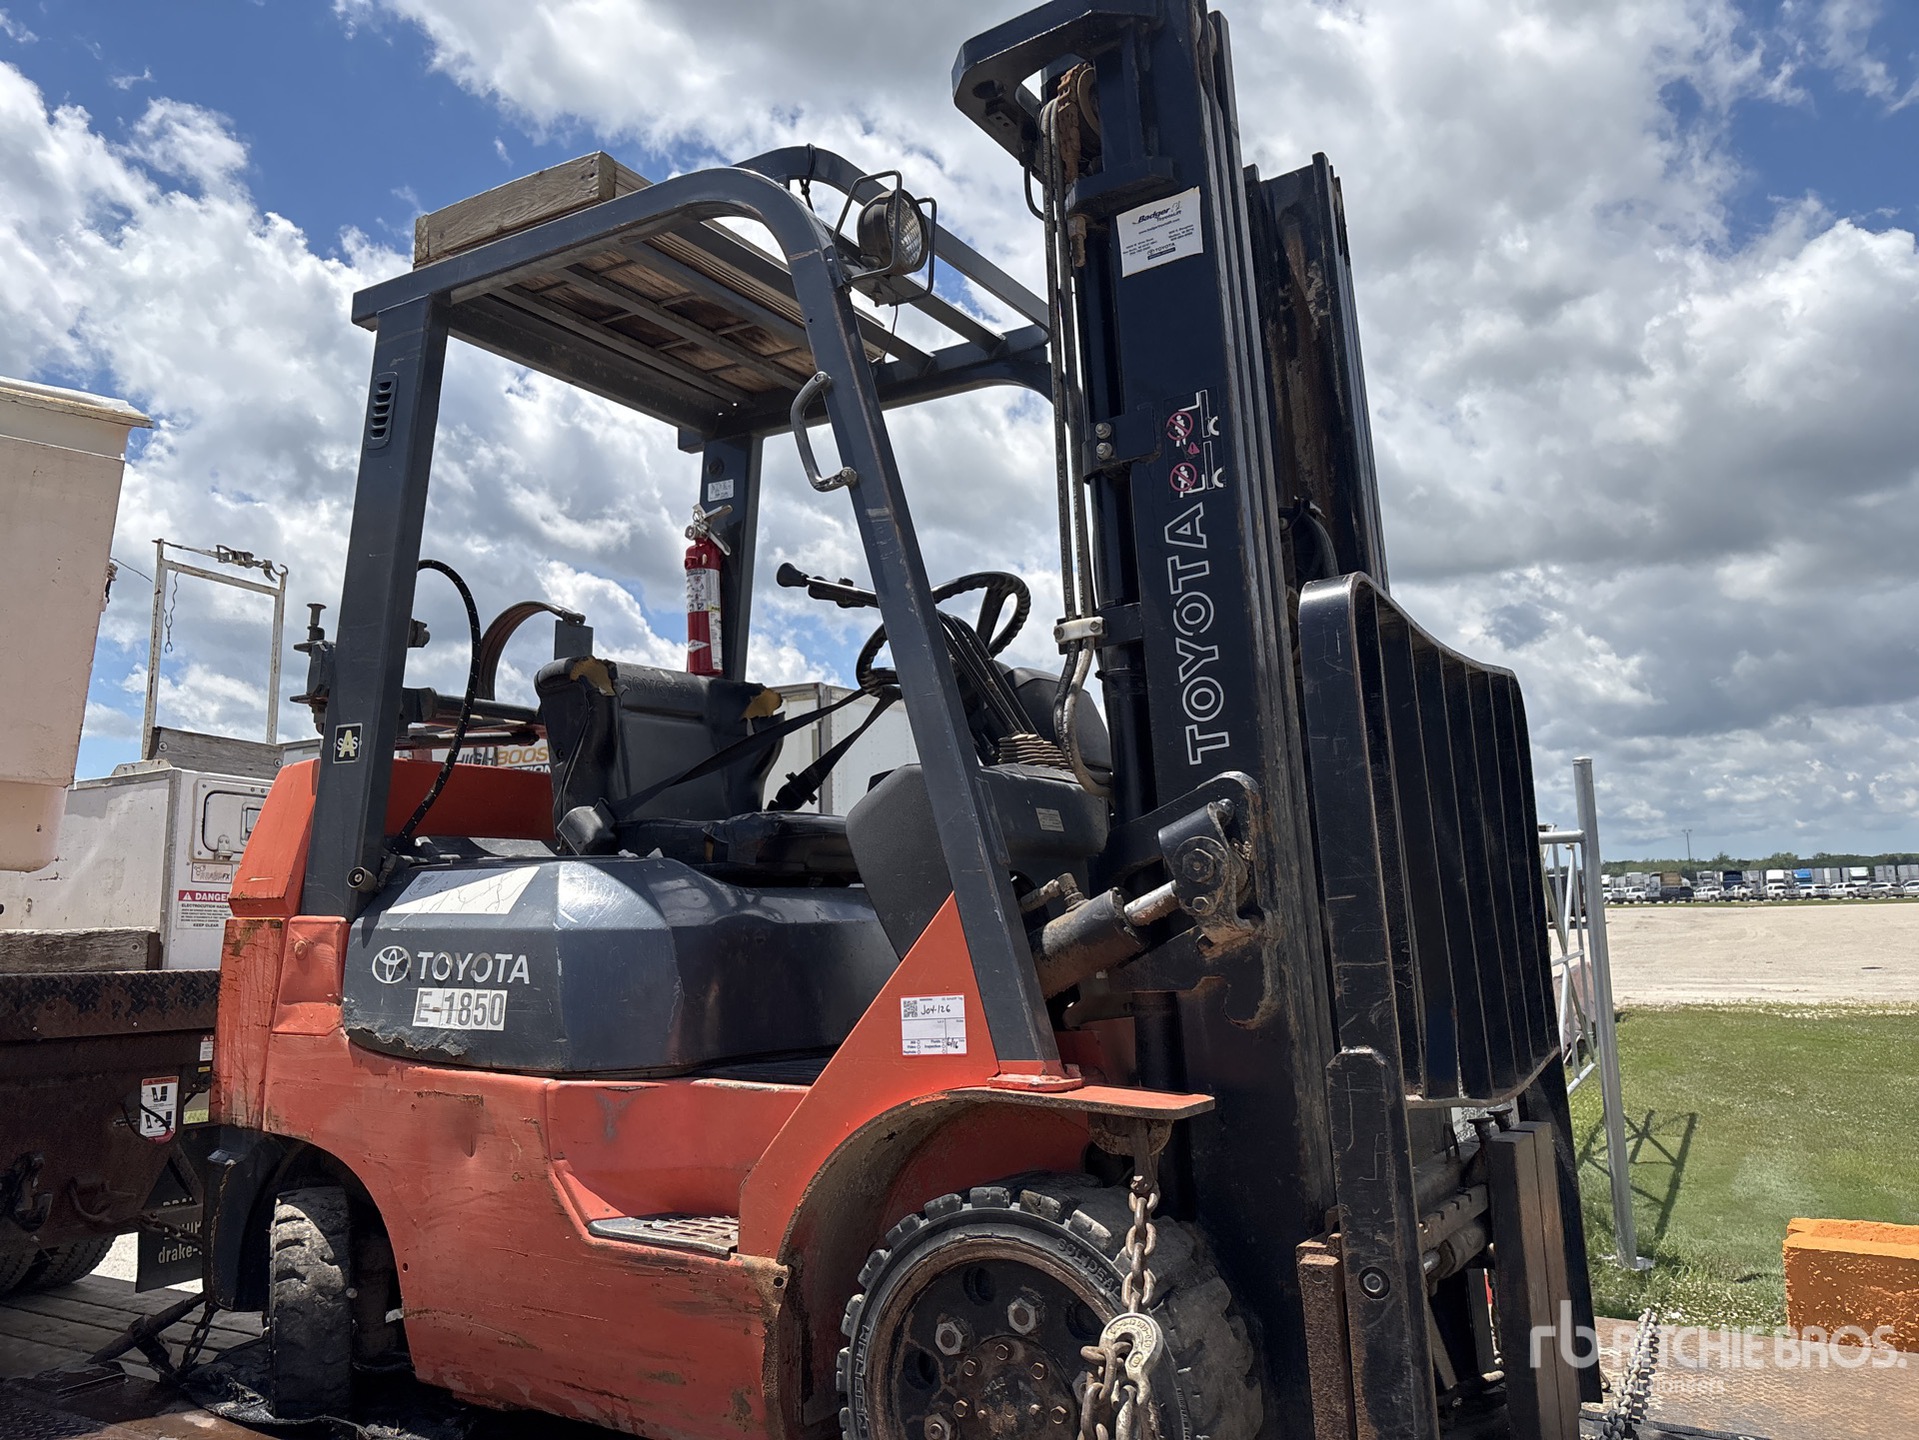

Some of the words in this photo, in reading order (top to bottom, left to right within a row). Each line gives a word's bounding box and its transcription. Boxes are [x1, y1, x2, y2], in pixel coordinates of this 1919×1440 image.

[1138, 208, 1170, 223] Badger
[1164, 501, 1230, 765] TOYOTA
[417, 951, 530, 985] TOYOTA
[158, 1243, 202, 1264] drake-
